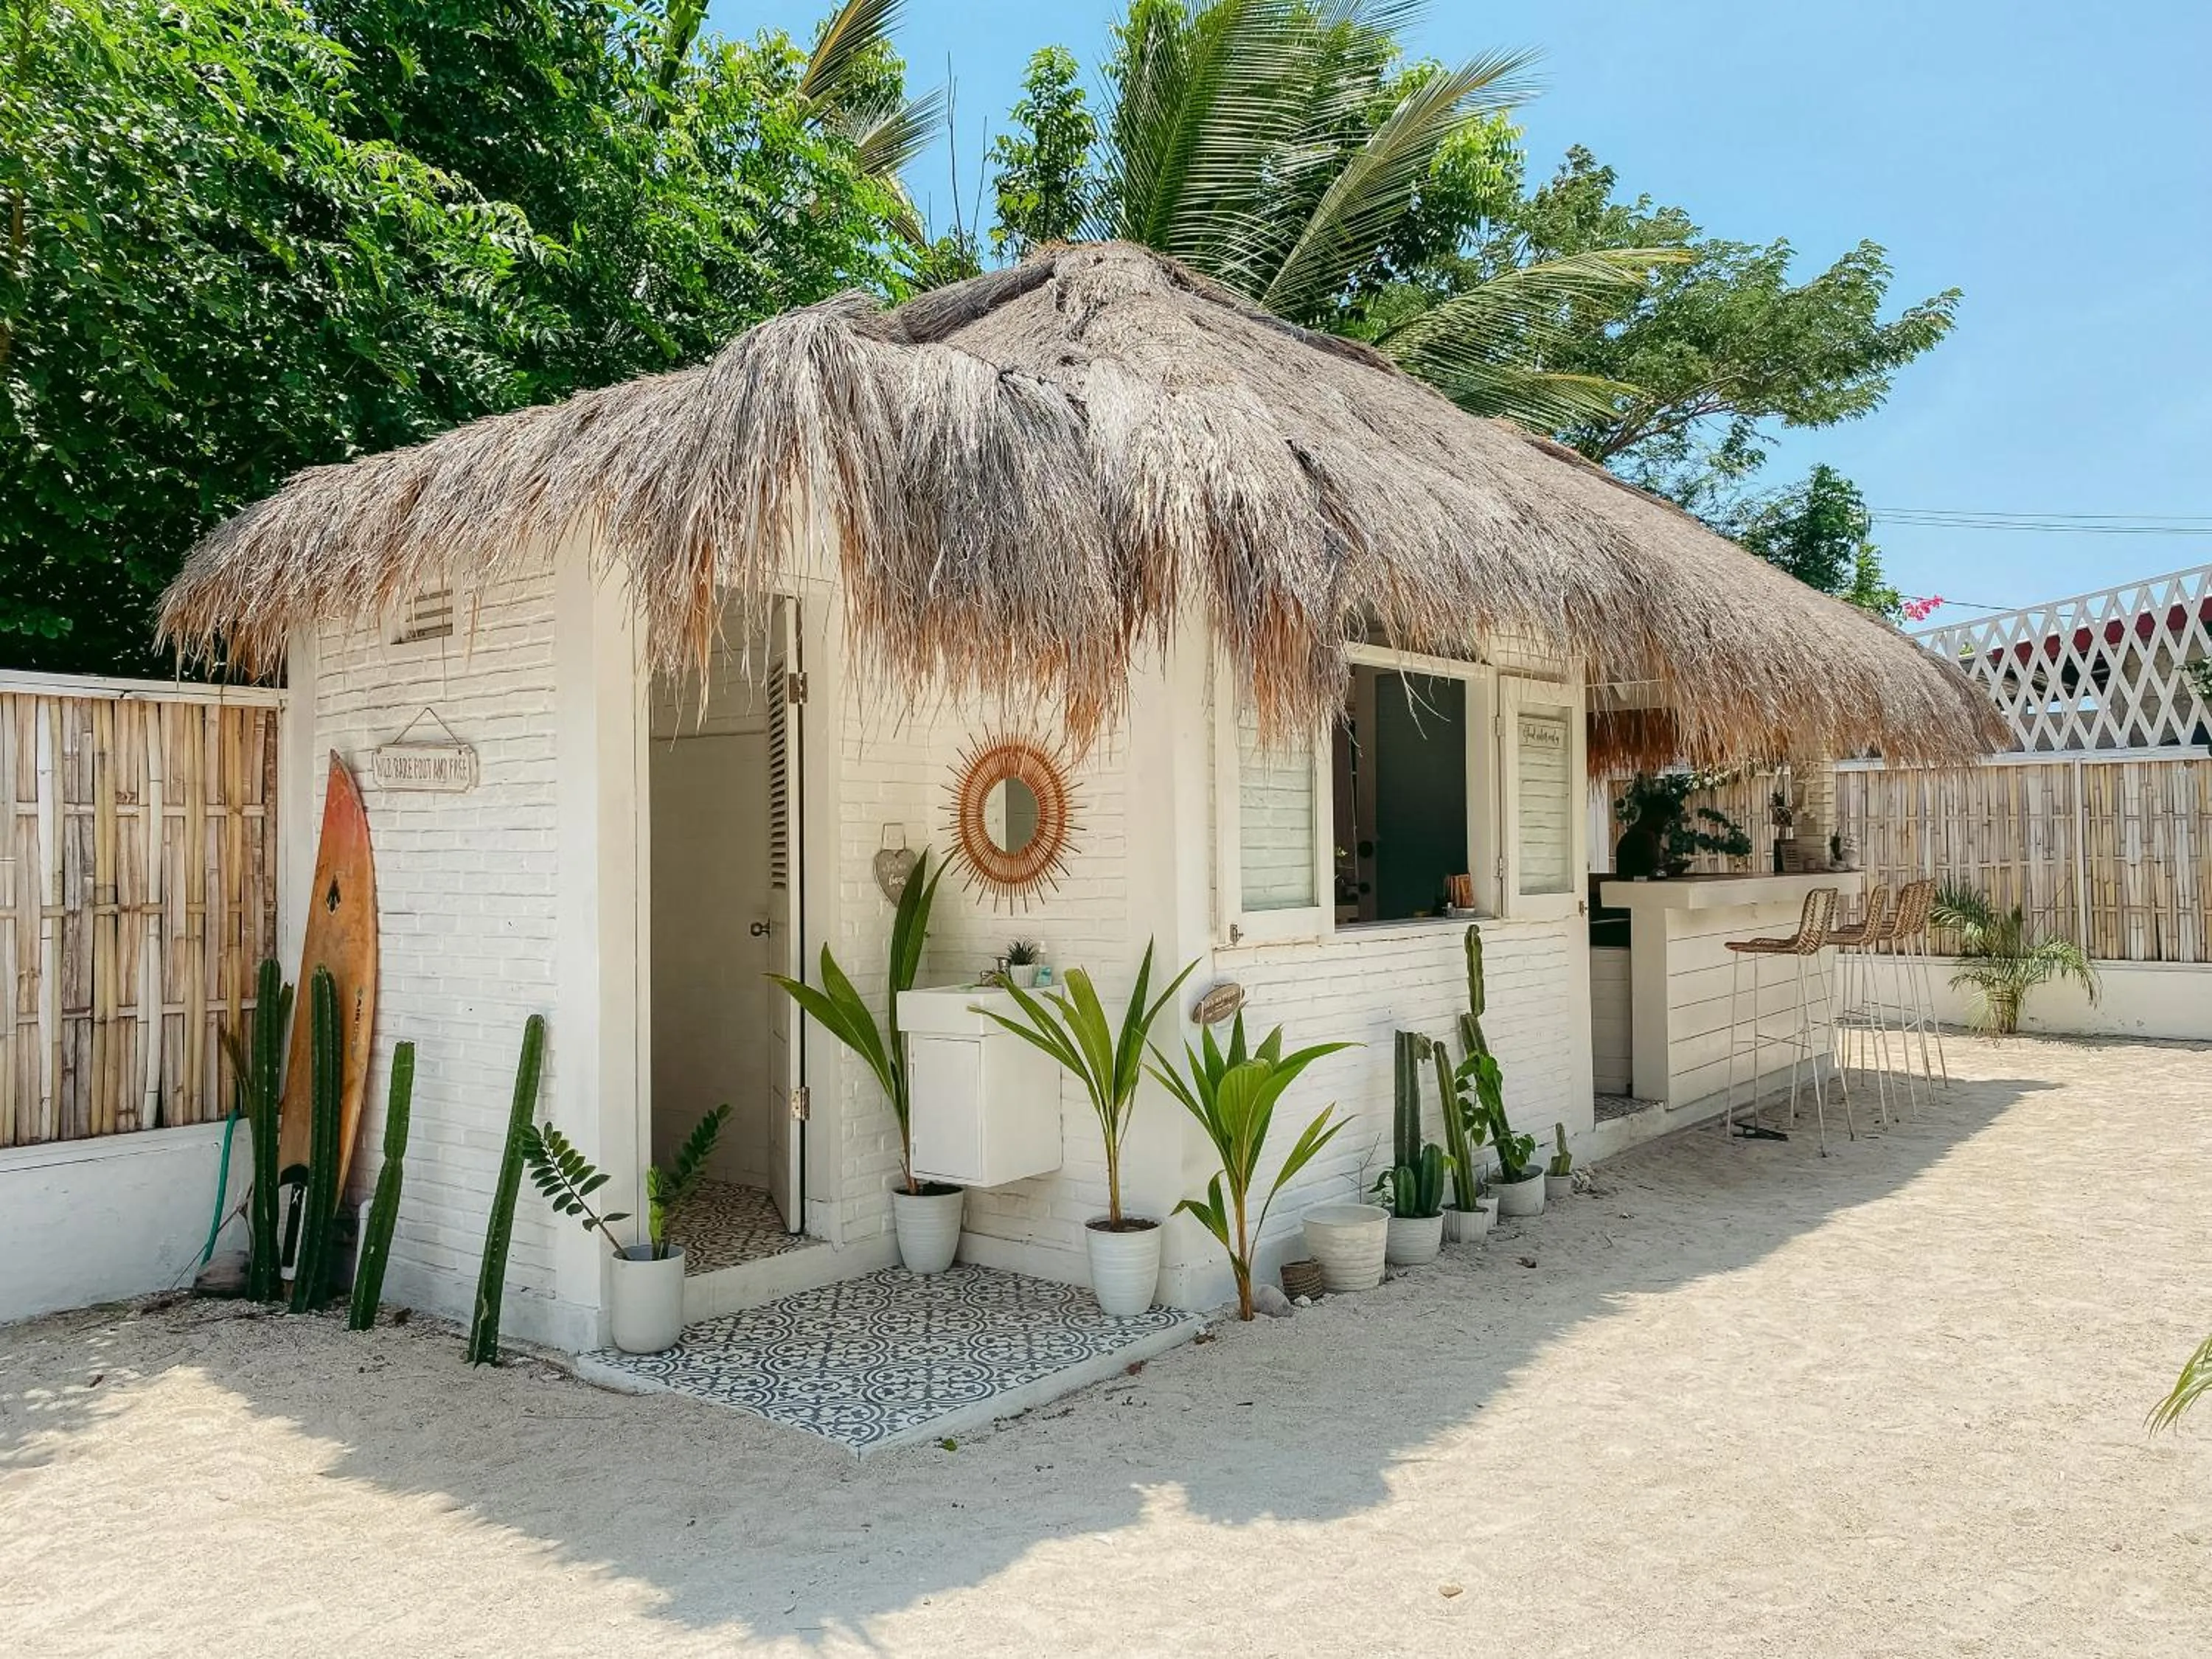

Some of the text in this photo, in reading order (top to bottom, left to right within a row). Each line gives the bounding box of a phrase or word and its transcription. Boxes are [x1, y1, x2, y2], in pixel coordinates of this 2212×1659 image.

[376, 757, 392, 778] WILD
[433, 757, 448, 779] AND
[449, 757, 467, 780] FREE
